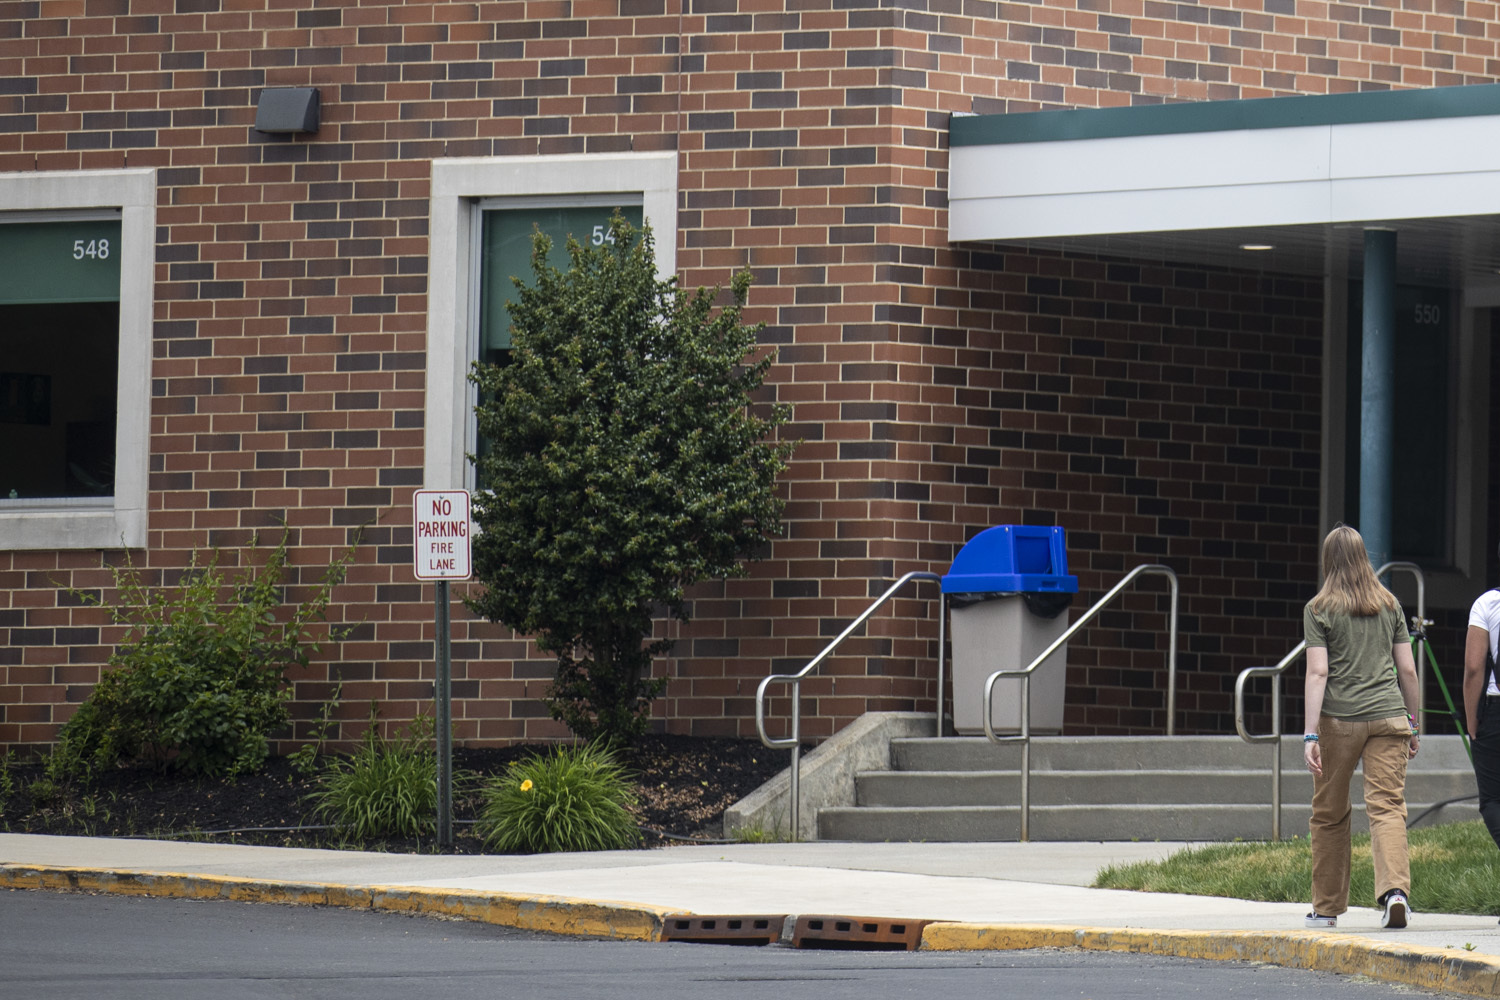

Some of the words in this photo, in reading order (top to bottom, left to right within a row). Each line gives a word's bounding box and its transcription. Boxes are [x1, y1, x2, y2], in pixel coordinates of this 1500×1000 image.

[592, 225, 617, 246] 54
[73, 238, 110, 260] 548
[1414, 303, 1440, 325] 550
[432, 499, 452, 516] NO
[418, 520, 466, 538] PARKING
[431, 542, 454, 554] FIRE
[429, 558, 455, 570] LANE
